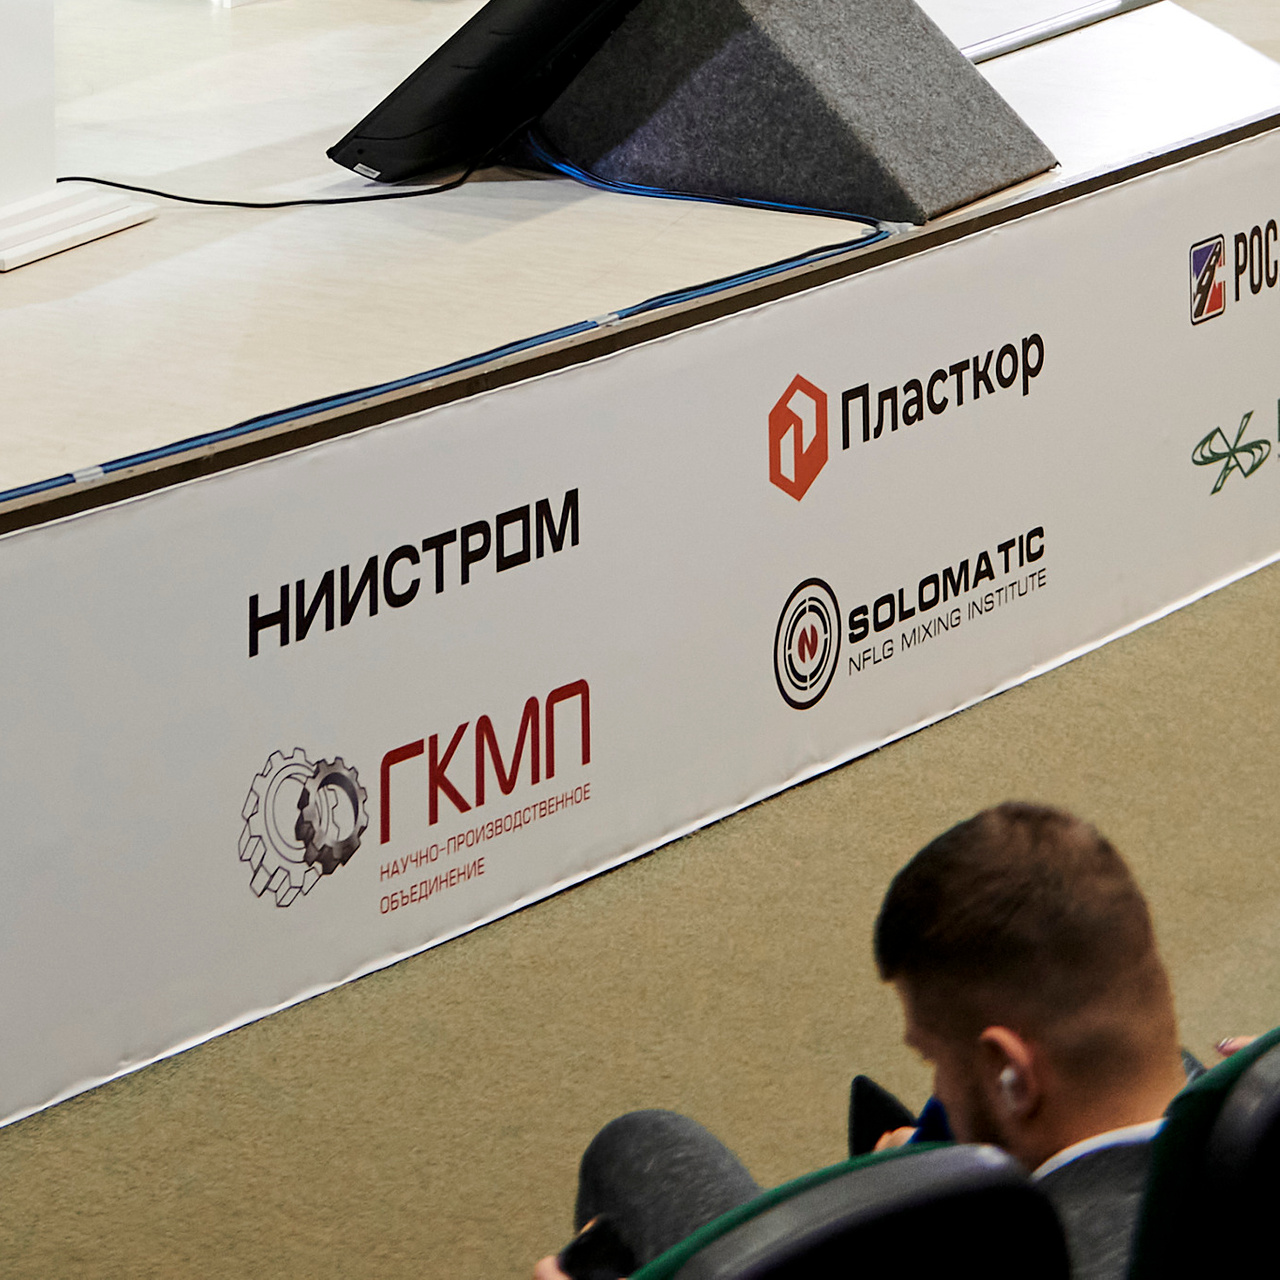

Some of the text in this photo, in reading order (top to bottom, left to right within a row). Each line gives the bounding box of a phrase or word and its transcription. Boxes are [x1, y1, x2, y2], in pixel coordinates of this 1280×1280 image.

[841, 332, 1045, 451] Пласткор
[248, 487, 580, 658] НИИСТРОМ
[848, 525, 1046, 644] SOLOMATIC
[849, 567, 1048, 676] NFLG MIXING INSTITUTE
[380, 678, 591, 846] ГКМП
[380, 782, 591, 883] НАУЧНО-ПРОИЗВОДСТВЕННОЕ
[380, 857, 486, 915] ОБЪЕДИНЕНИЕ
